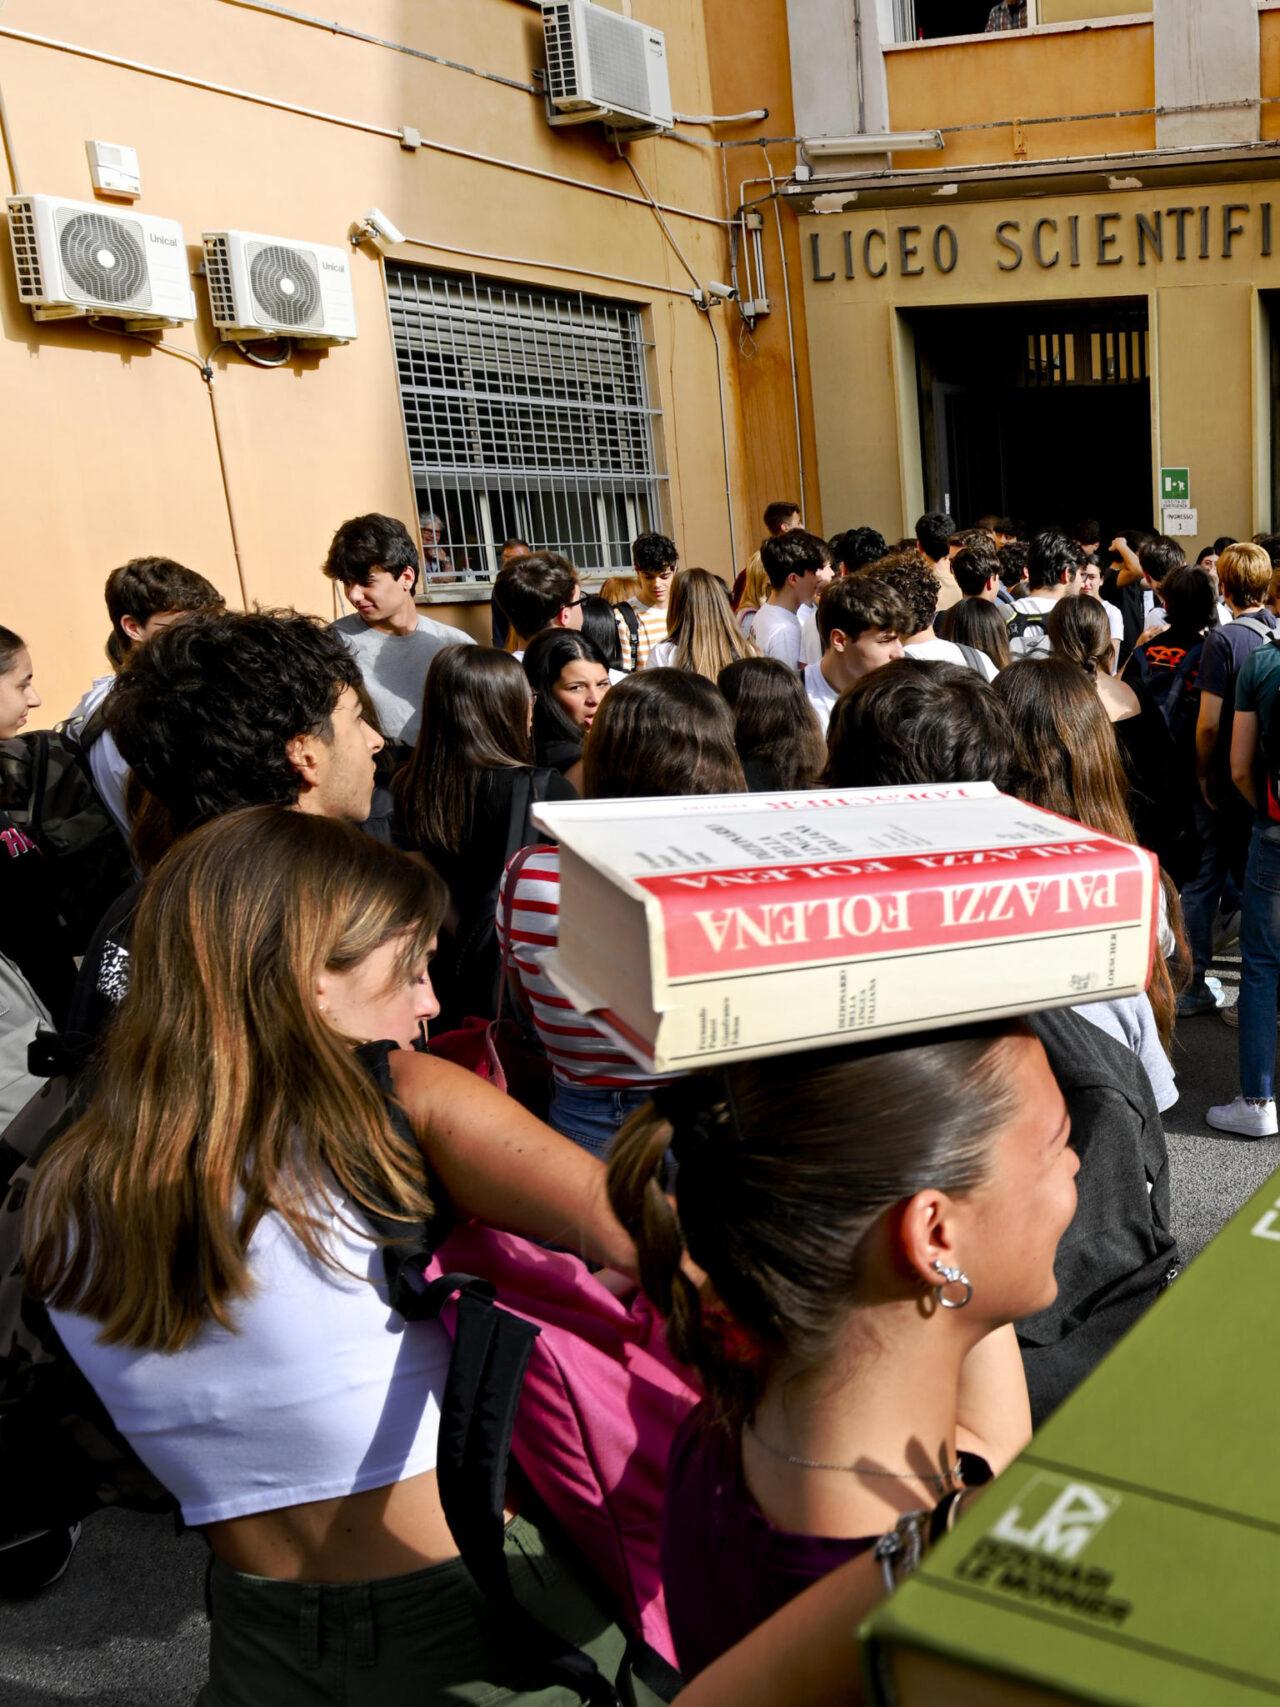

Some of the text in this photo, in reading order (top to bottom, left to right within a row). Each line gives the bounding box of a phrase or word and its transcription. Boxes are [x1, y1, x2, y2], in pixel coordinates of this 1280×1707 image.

[149, 232, 178, 247] Unical
[810, 224, 958, 281] LICEO
[322, 261, 345, 273] Unical
[670, 843, 1100, 889] PALAZZI FOLENA
[694, 871, 1119, 953] PALAZZI FOLENA
